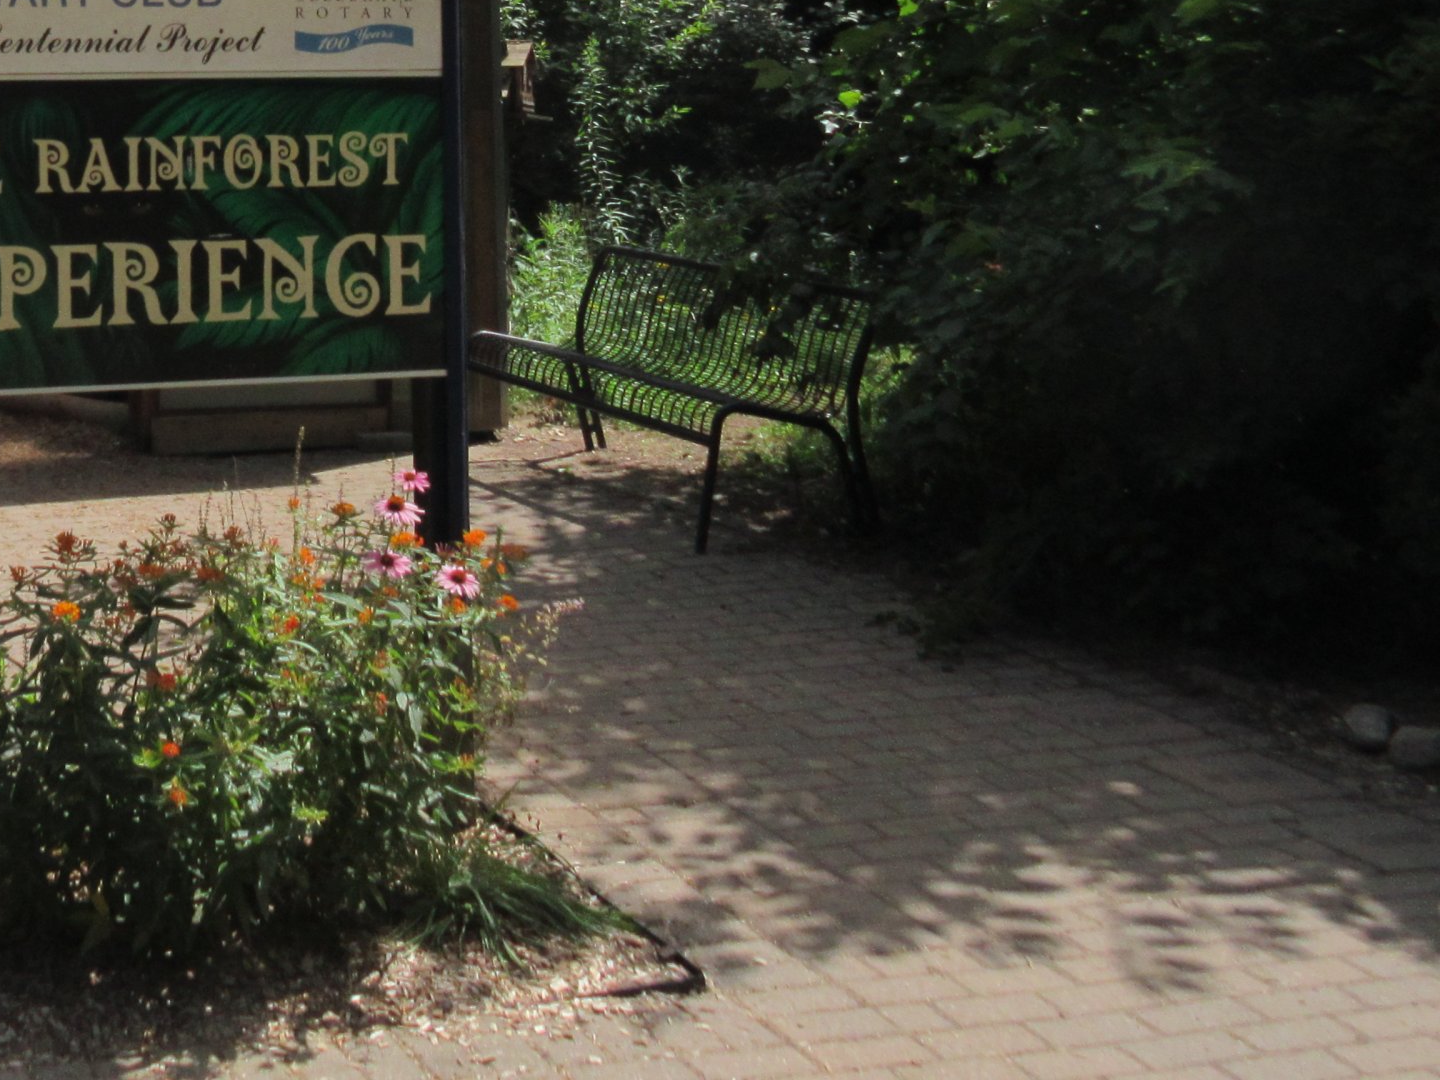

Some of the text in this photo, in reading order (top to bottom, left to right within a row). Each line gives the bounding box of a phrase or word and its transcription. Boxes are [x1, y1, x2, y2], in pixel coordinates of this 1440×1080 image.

[295, 7, 413, 19] ROTARY
[156, 24, 265, 63] Project
[318, 37, 350, 51] 100
[34, 132, 408, 193] RAINFOREST
